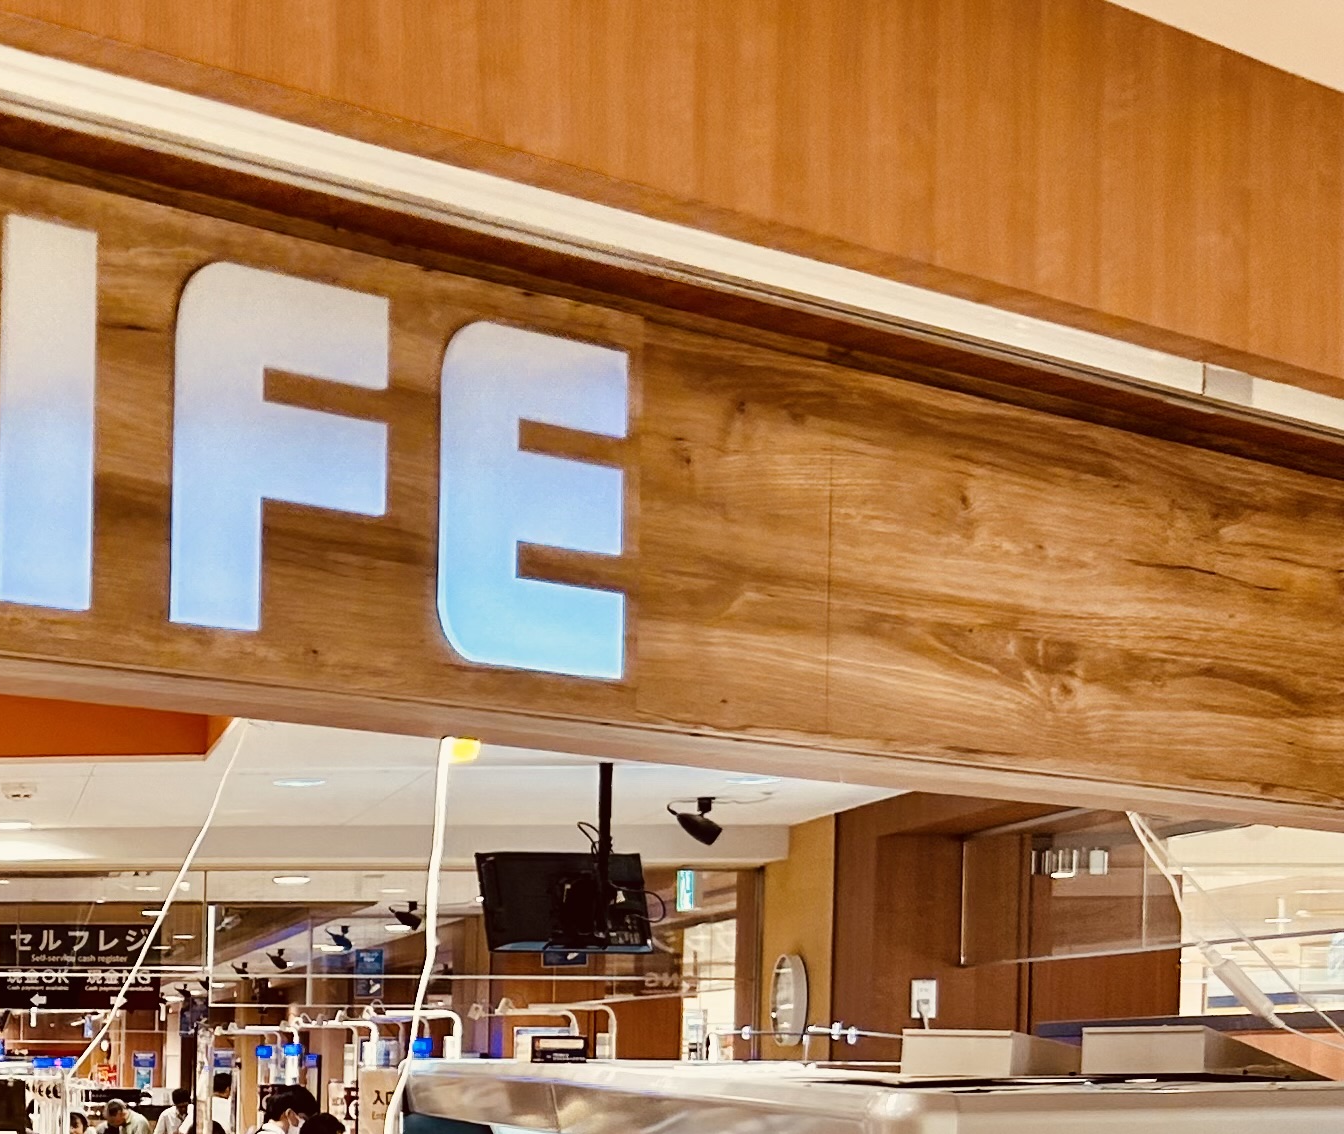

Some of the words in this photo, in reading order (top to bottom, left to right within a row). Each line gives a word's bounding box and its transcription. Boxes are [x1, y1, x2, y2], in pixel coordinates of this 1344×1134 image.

[10, 928, 150, 952] セルフレジ
[97, 954, 129, 965] register
